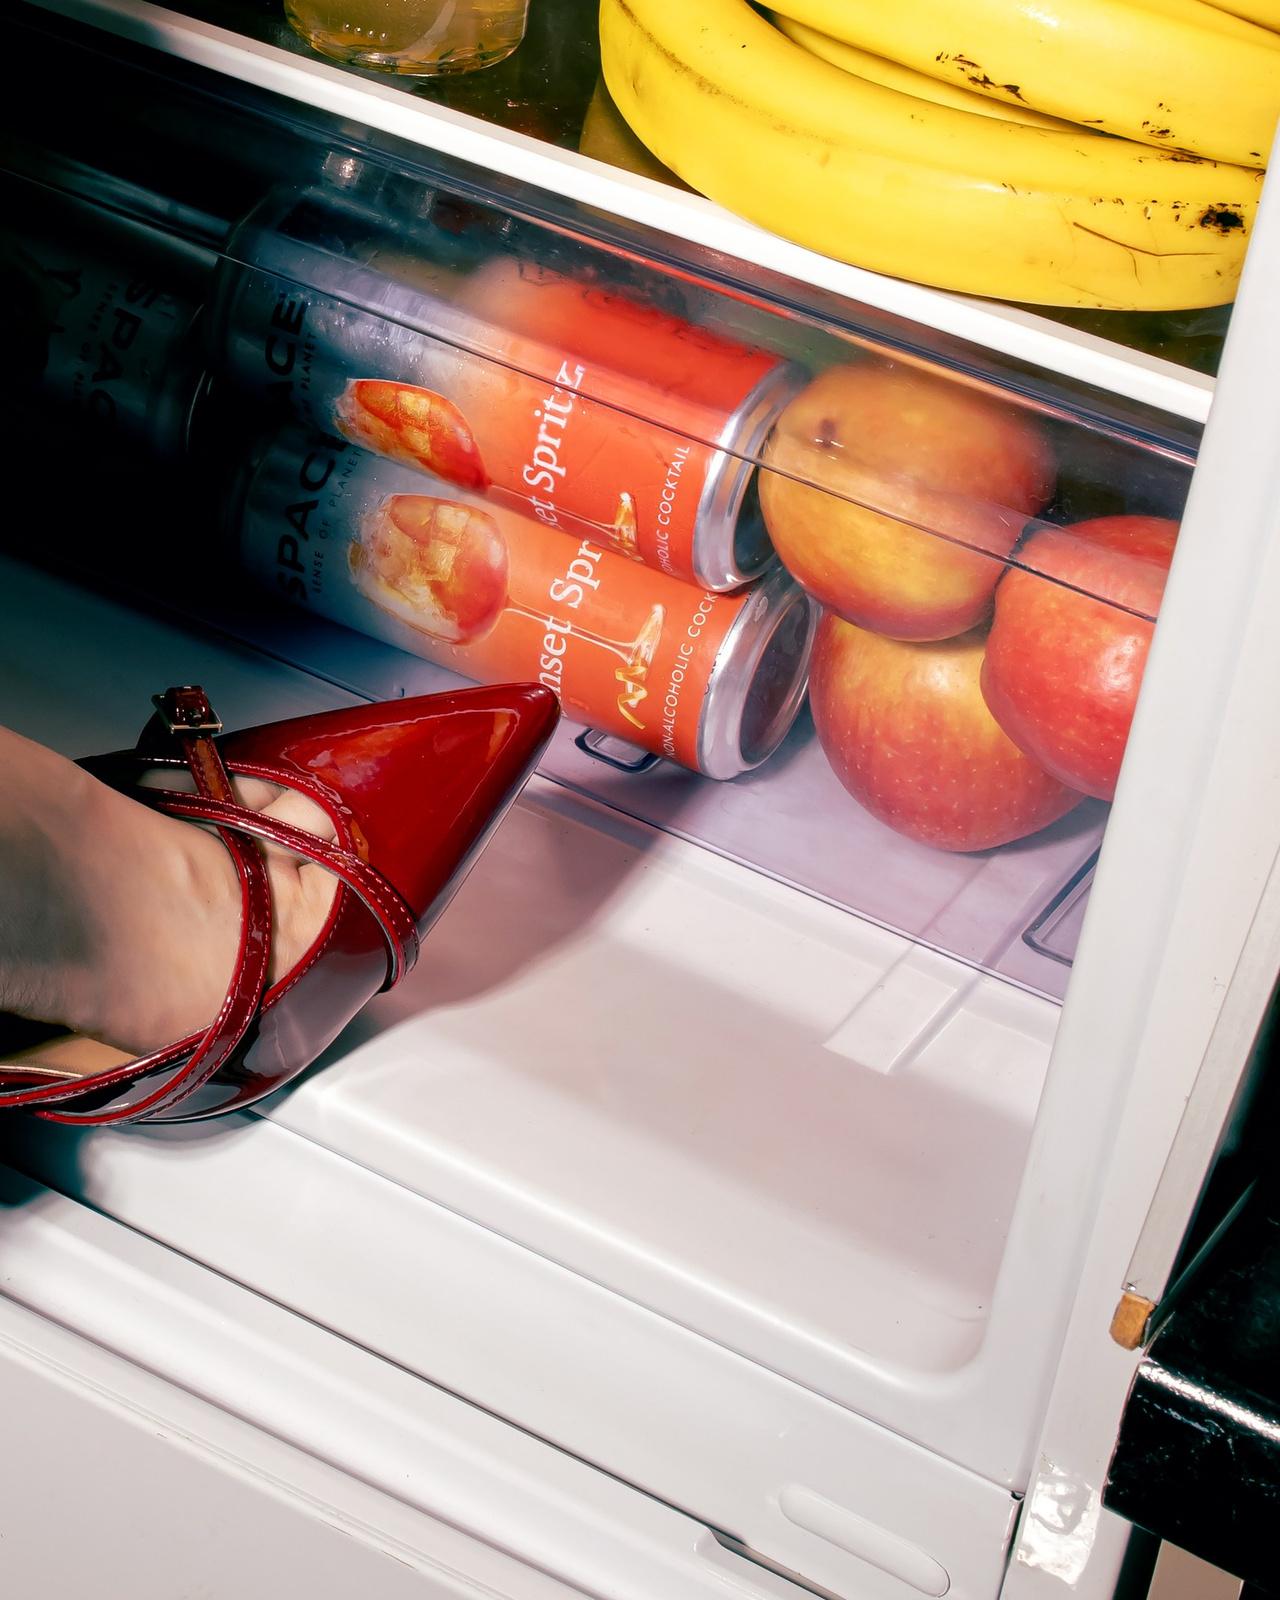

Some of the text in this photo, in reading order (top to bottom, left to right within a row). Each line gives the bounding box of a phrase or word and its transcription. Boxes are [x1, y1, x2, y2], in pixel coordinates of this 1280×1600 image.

[523, 360, 586, 492] Spritz
[319, 519, 331, 540] OF
[328, 450, 361, 507] PLANET
[658, 446, 690, 525] COCKTAIL
[549, 539, 602, 609] Spr
[663, 592, 718, 757] NON-ALCOHOLIC COCK
